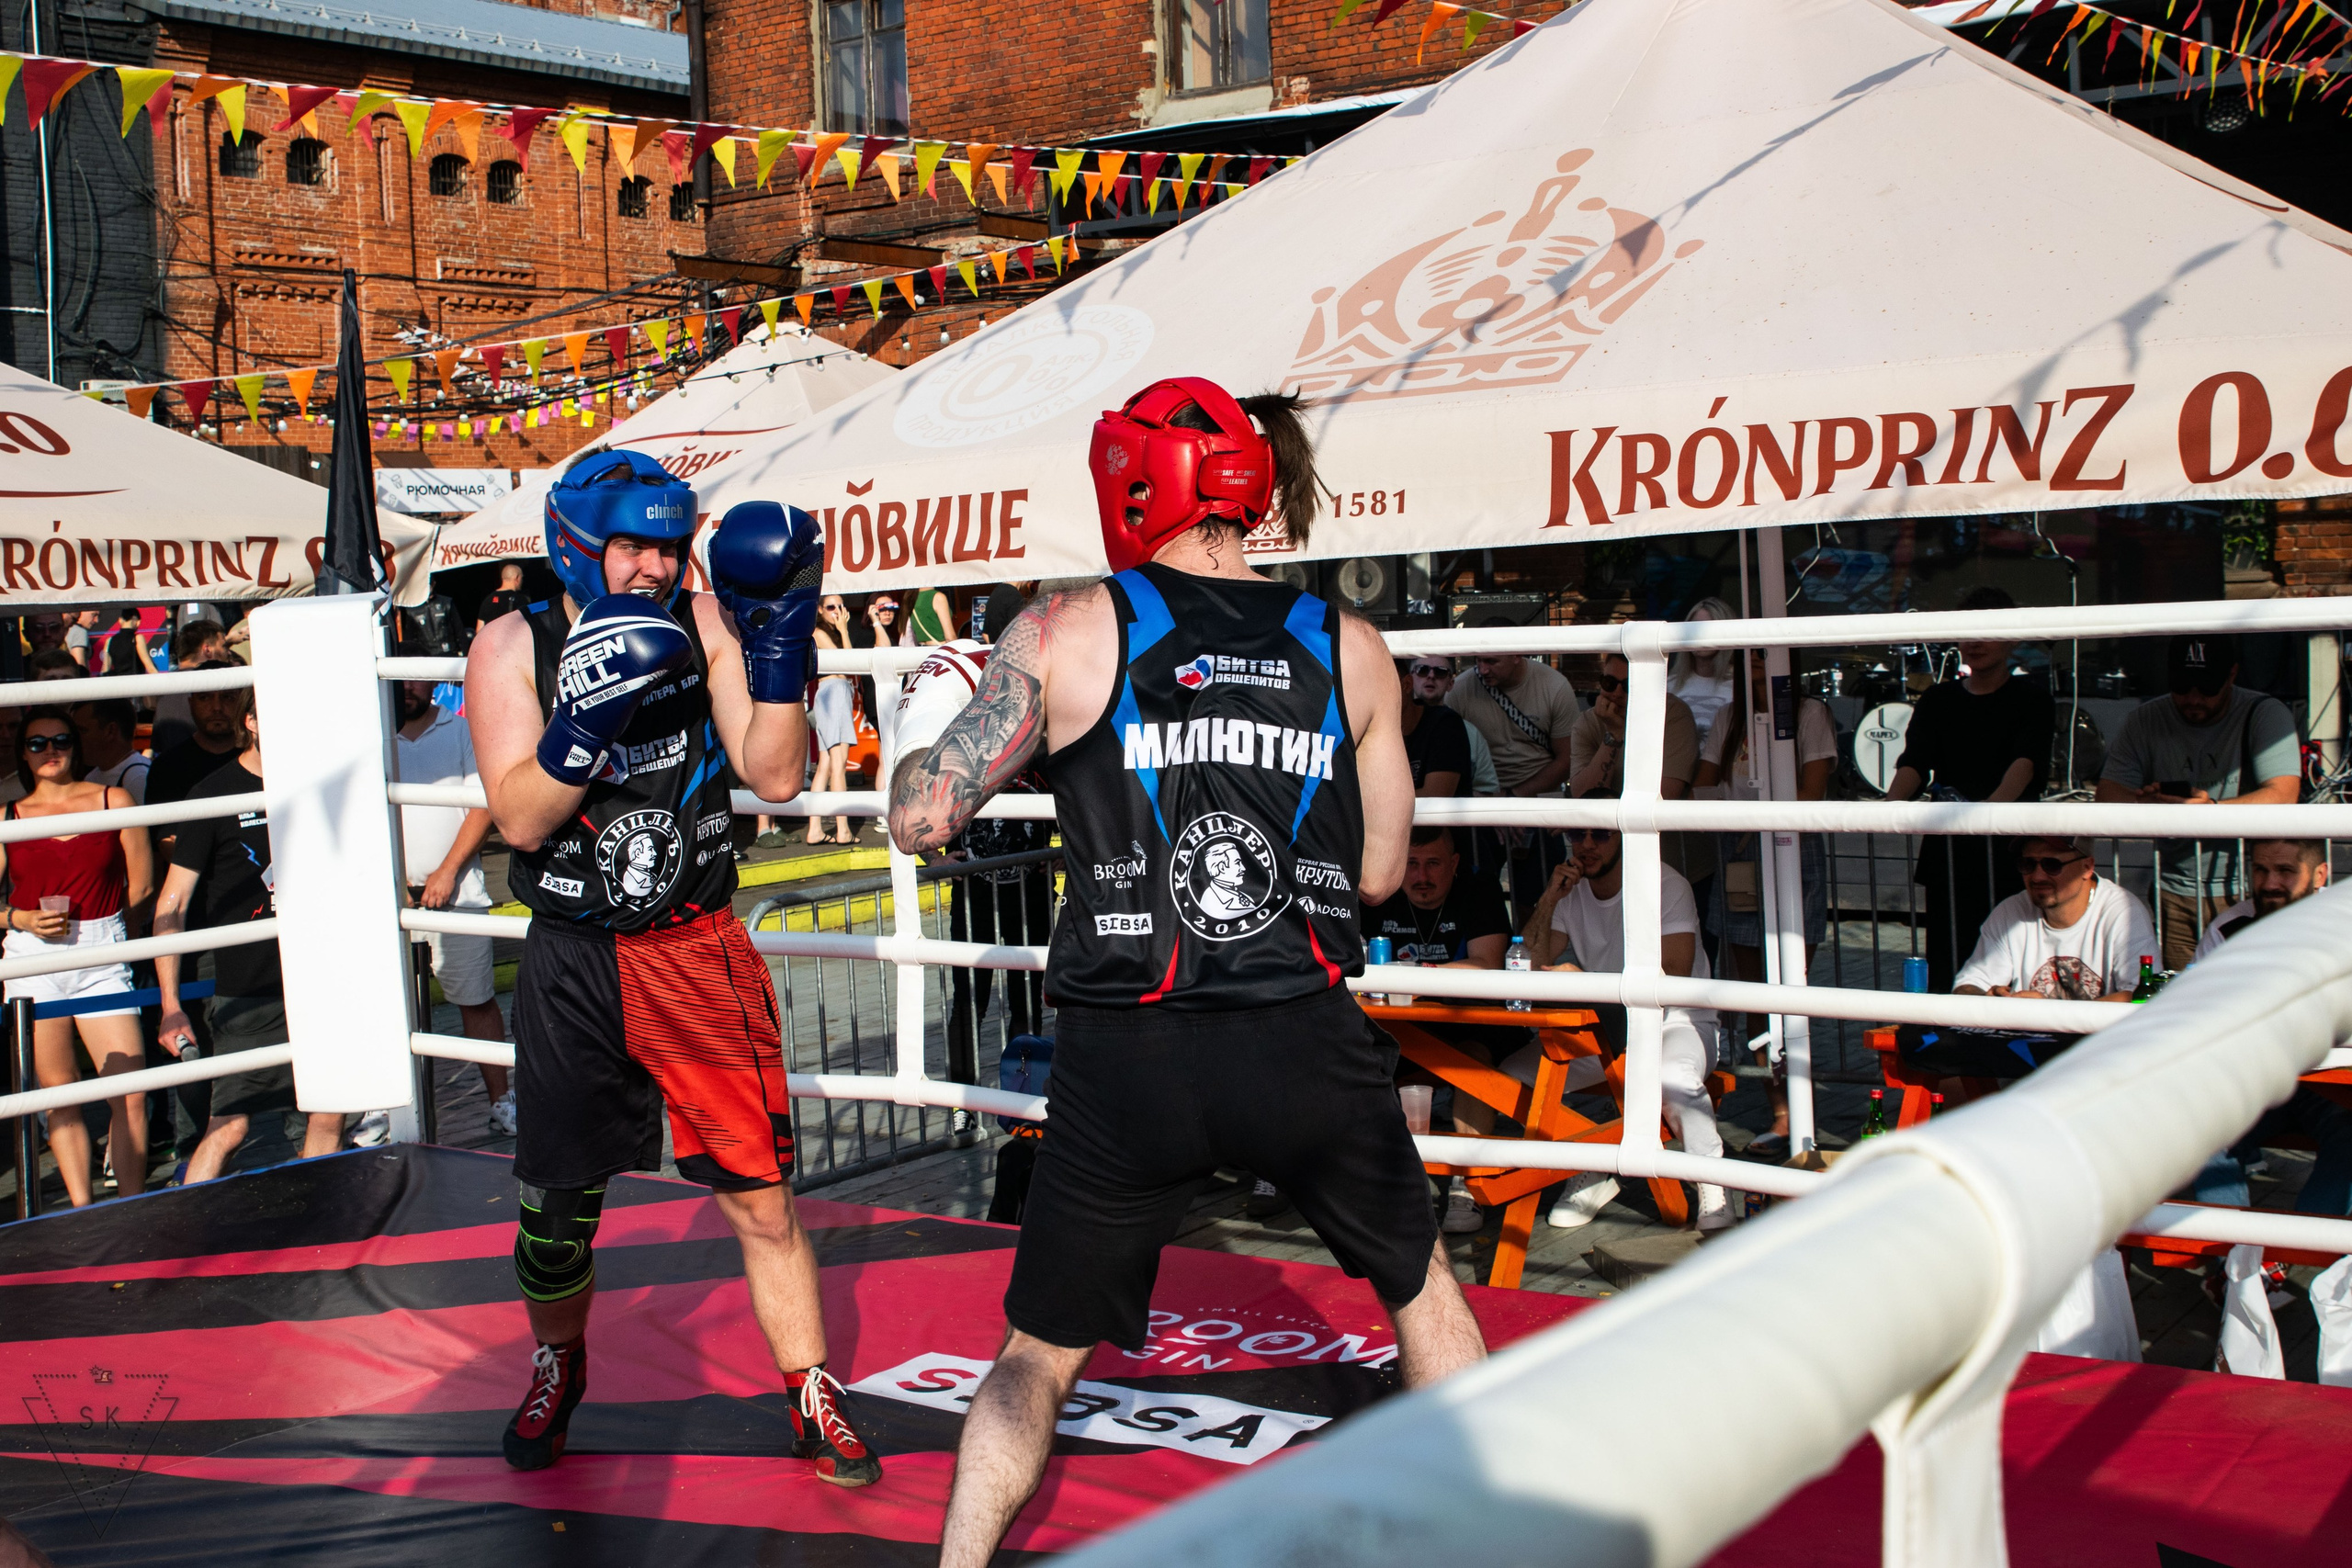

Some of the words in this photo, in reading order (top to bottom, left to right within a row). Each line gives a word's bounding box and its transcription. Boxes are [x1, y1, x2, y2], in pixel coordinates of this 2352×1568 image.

[1539, 383, 2136, 530] KRÓNPRINZ
[407, 484, 486, 497] РЮМОЧНАЯ
[1333, 489, 1407, 519] 1581
[0, 520, 292, 595] RÓNPRINZ
[558, 635, 627, 682] GREEN
[1216, 655, 1291, 678] БИТВА
[558, 661, 622, 704] HILL
[1215, 672, 1291, 690] ОБЩЕПИТОВ
[628, 728, 688, 764] БИТВА
[1093, 859, 1147, 881] BROOM
[1114, 880, 1133, 889] GIN
[1099, 917, 1150, 931] SIBSA
[1193, 908, 1271, 935] 2010
[1146, 1309, 1398, 1370] ROOM
[1122, 1345, 1234, 1371] GIN
[895, 1368, 1267, 1450] SBSA
